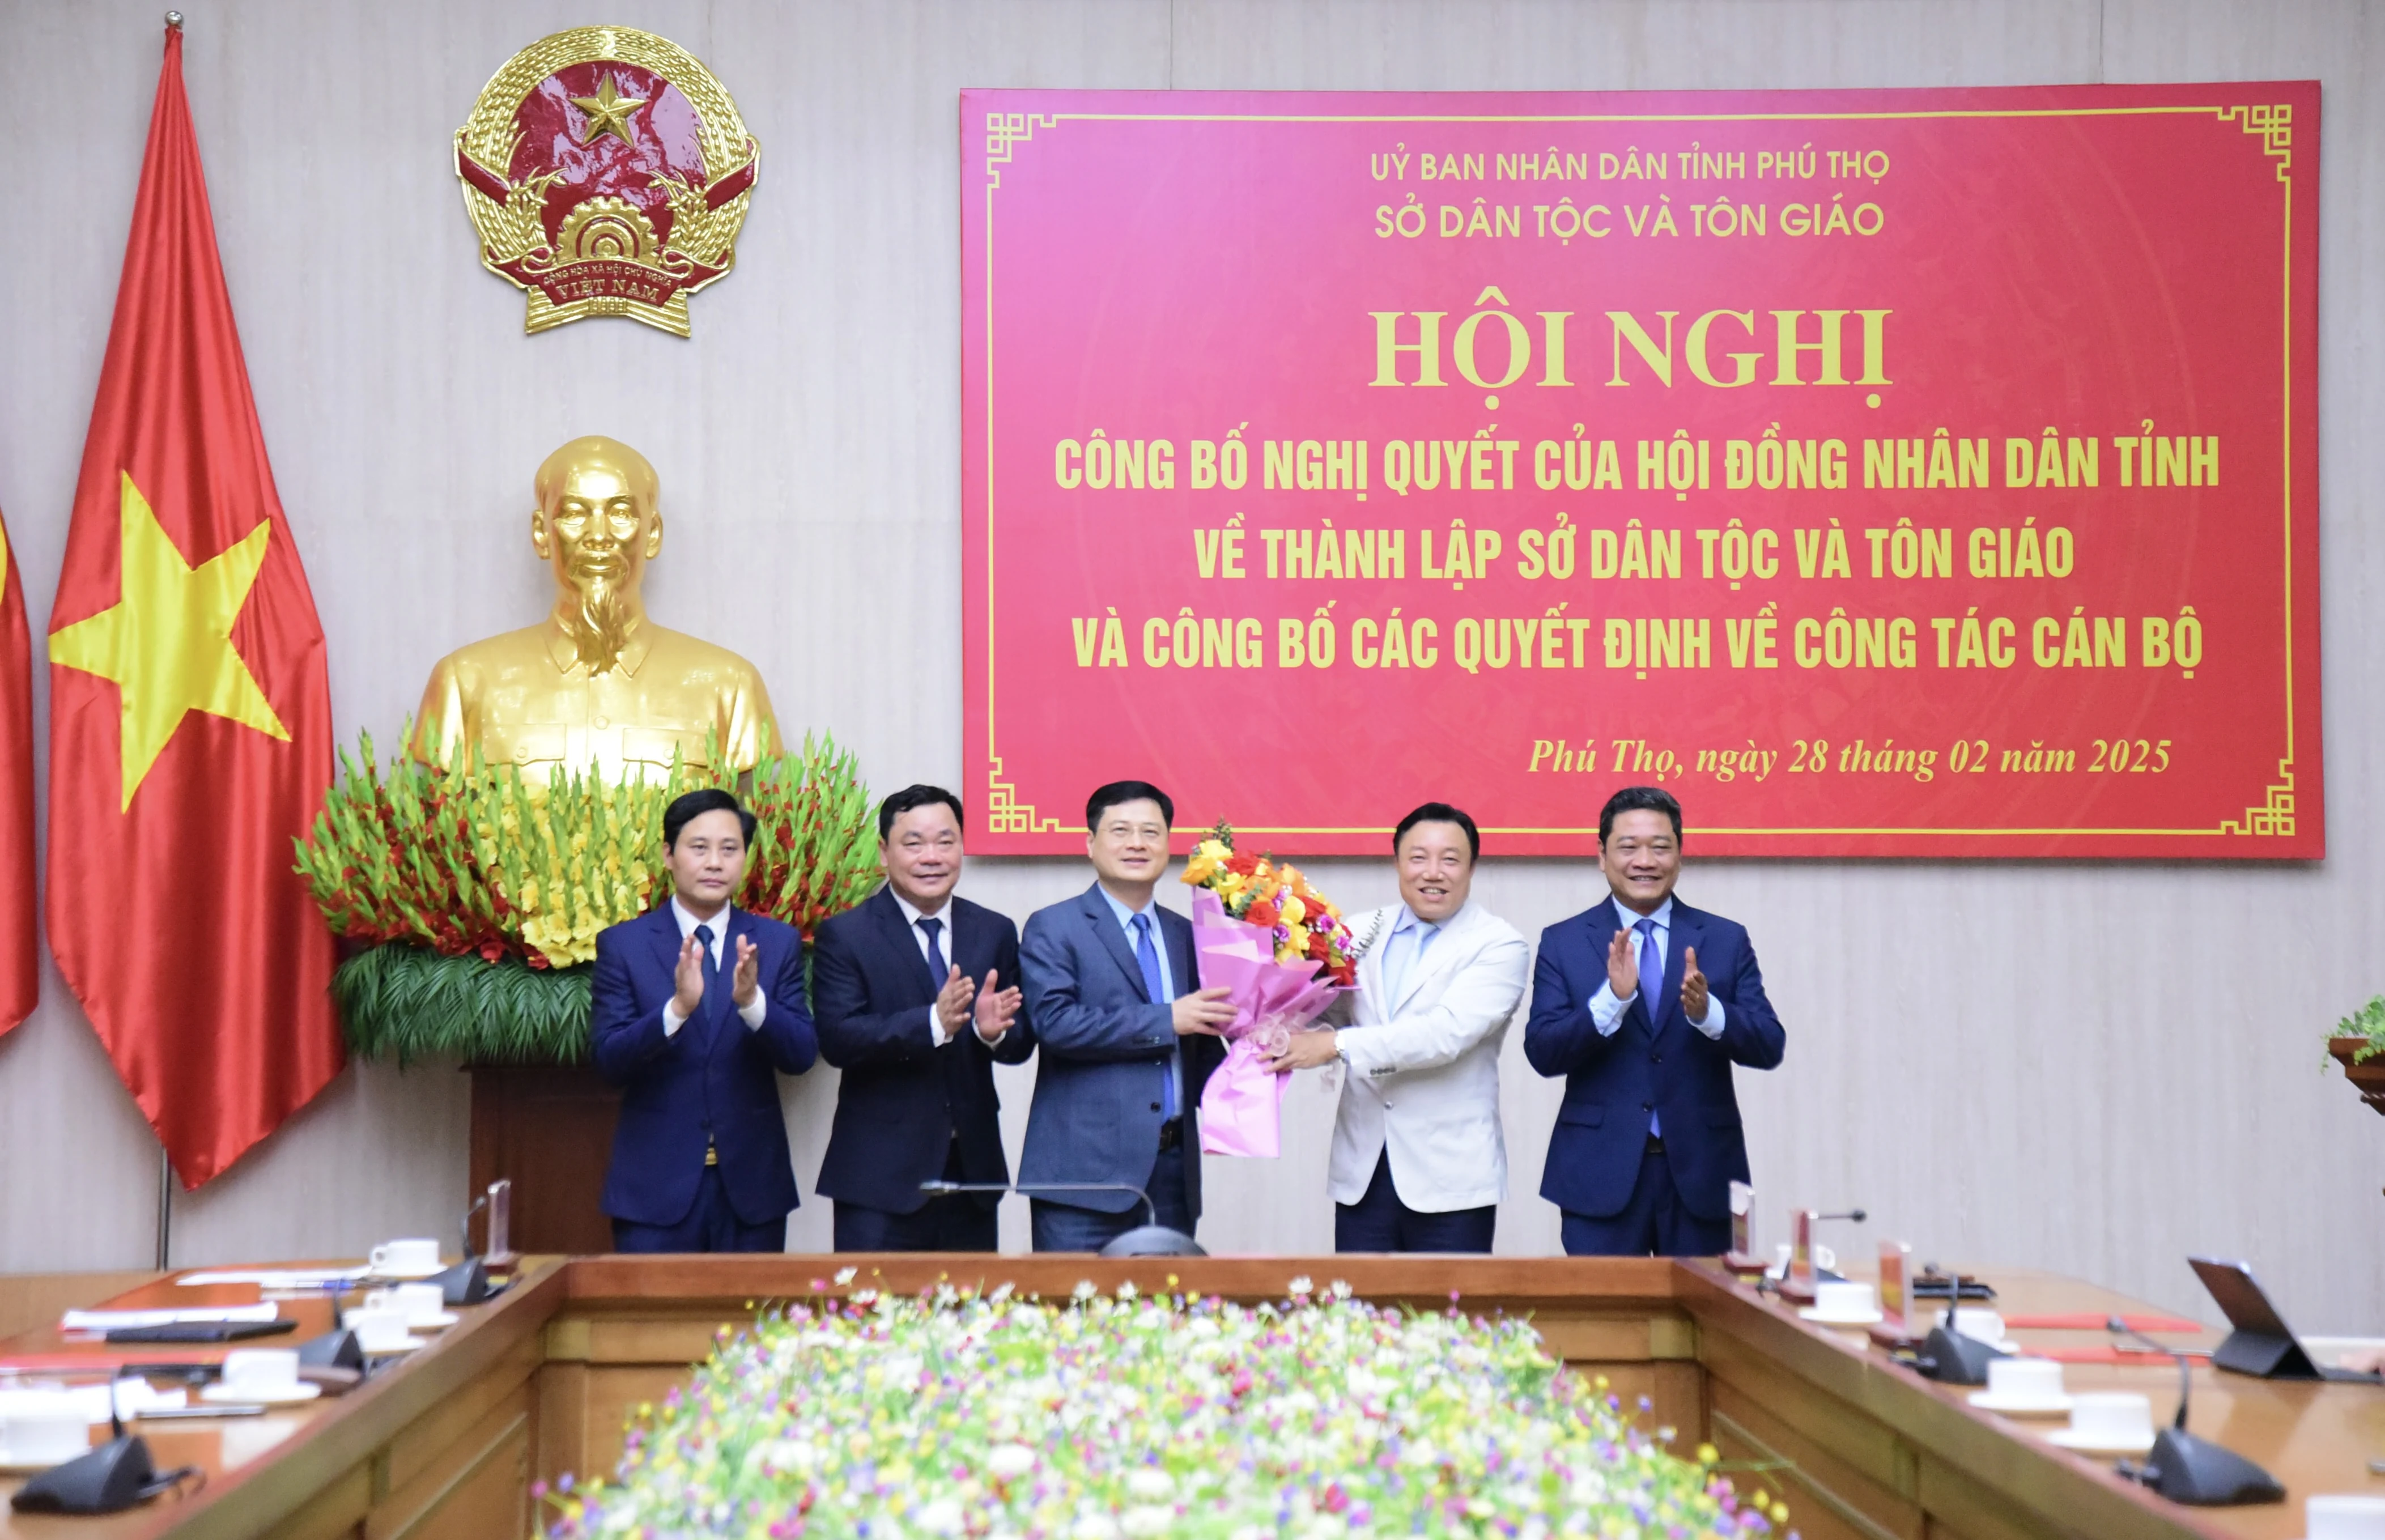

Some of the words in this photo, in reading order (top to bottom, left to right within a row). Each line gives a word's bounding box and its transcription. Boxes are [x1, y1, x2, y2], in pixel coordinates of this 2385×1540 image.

[1371, 142, 1410, 181] UỶ
[1421, 153, 1483, 180] BAN
[1497, 146, 1587, 180] NHÂN
[1600, 146, 1667, 179] DÂN
[1678, 142, 1745, 179] TỈNH
[1757, 142, 1816, 178] PHÚ
[1827, 150, 1890, 185] THỌ
[1375, 192, 1426, 238] SỞ
[1440, 197, 1520, 237] DÂN
[1533, 197, 1612, 245] TỘC
[1623, 193, 1678, 237] VÀ
[1690, 195, 1766, 237] TÔN
[1780, 192, 1884, 236] GIÁO
[556, 277, 605, 299] VIỆT
[611, 279, 660, 302] NAM
[592, 263, 605, 273] XÃ
[606, 263, 622, 276] HỘI
[624, 266, 643, 278] CHỦ
[1368, 286, 1574, 410] HỘI
[1605, 309, 1893, 409] NGHỊ
[1056, 428, 1175, 490] CÔNG
[1191, 422, 1248, 490] BỐ
[1264, 440, 1368, 501] NGHỊ
[1384, 424, 1520, 496] QUYẾT
[1534, 423, 1623, 491] CỦA
[1638, 429, 1710, 501] HỘI
[1724, 422, 1848, 490] ĐỒNG
[1863, 427, 1990, 490] NHÂN
[2005, 426, 2099, 488] DÂN
[2114, 418, 2220, 487] TỈNH
[1194, 512, 1246, 578] VỀ
[1261, 518, 1405, 579] THÀNH
[1421, 518, 1502, 591] LẬP
[1517, 512, 1577, 580] SỞ
[1591, 518, 1682, 580] DÂN
[1695, 518, 1780, 591] TỘC
[1794, 517, 1852, 579] VÀ
[1864, 517, 1953, 580] TÔN
[1968, 516, 2074, 579] GIÁO
[1072, 606, 1129, 667] VÀ
[1143, 607, 1263, 669] CÔNG
[1279, 600, 1336, 669] BỐ
[1351, 607, 1439, 669] CÁC
[1454, 602, 1591, 674] QUYẾT
[1603, 618, 1711, 680] ĐỊNH
[1725, 601, 1779, 669] VỀ
[1794, 606, 1917, 669] CÔNG
[1930, 606, 2017, 669] TÁC
[2032, 605, 2127, 669] CÁN
[2141, 605, 2203, 680] BỘ
[1529, 739, 1597, 772] Phú
[1613, 739, 1684, 782] Thọ,
[1697, 739, 1778, 783] ngày
[1788, 739, 1829, 773] 28
[1839, 738, 1938, 782] tháng
[1949, 739, 1990, 773] 02
[2000, 741, 2076, 773] năm
[2087, 738, 2172, 773] 2025
